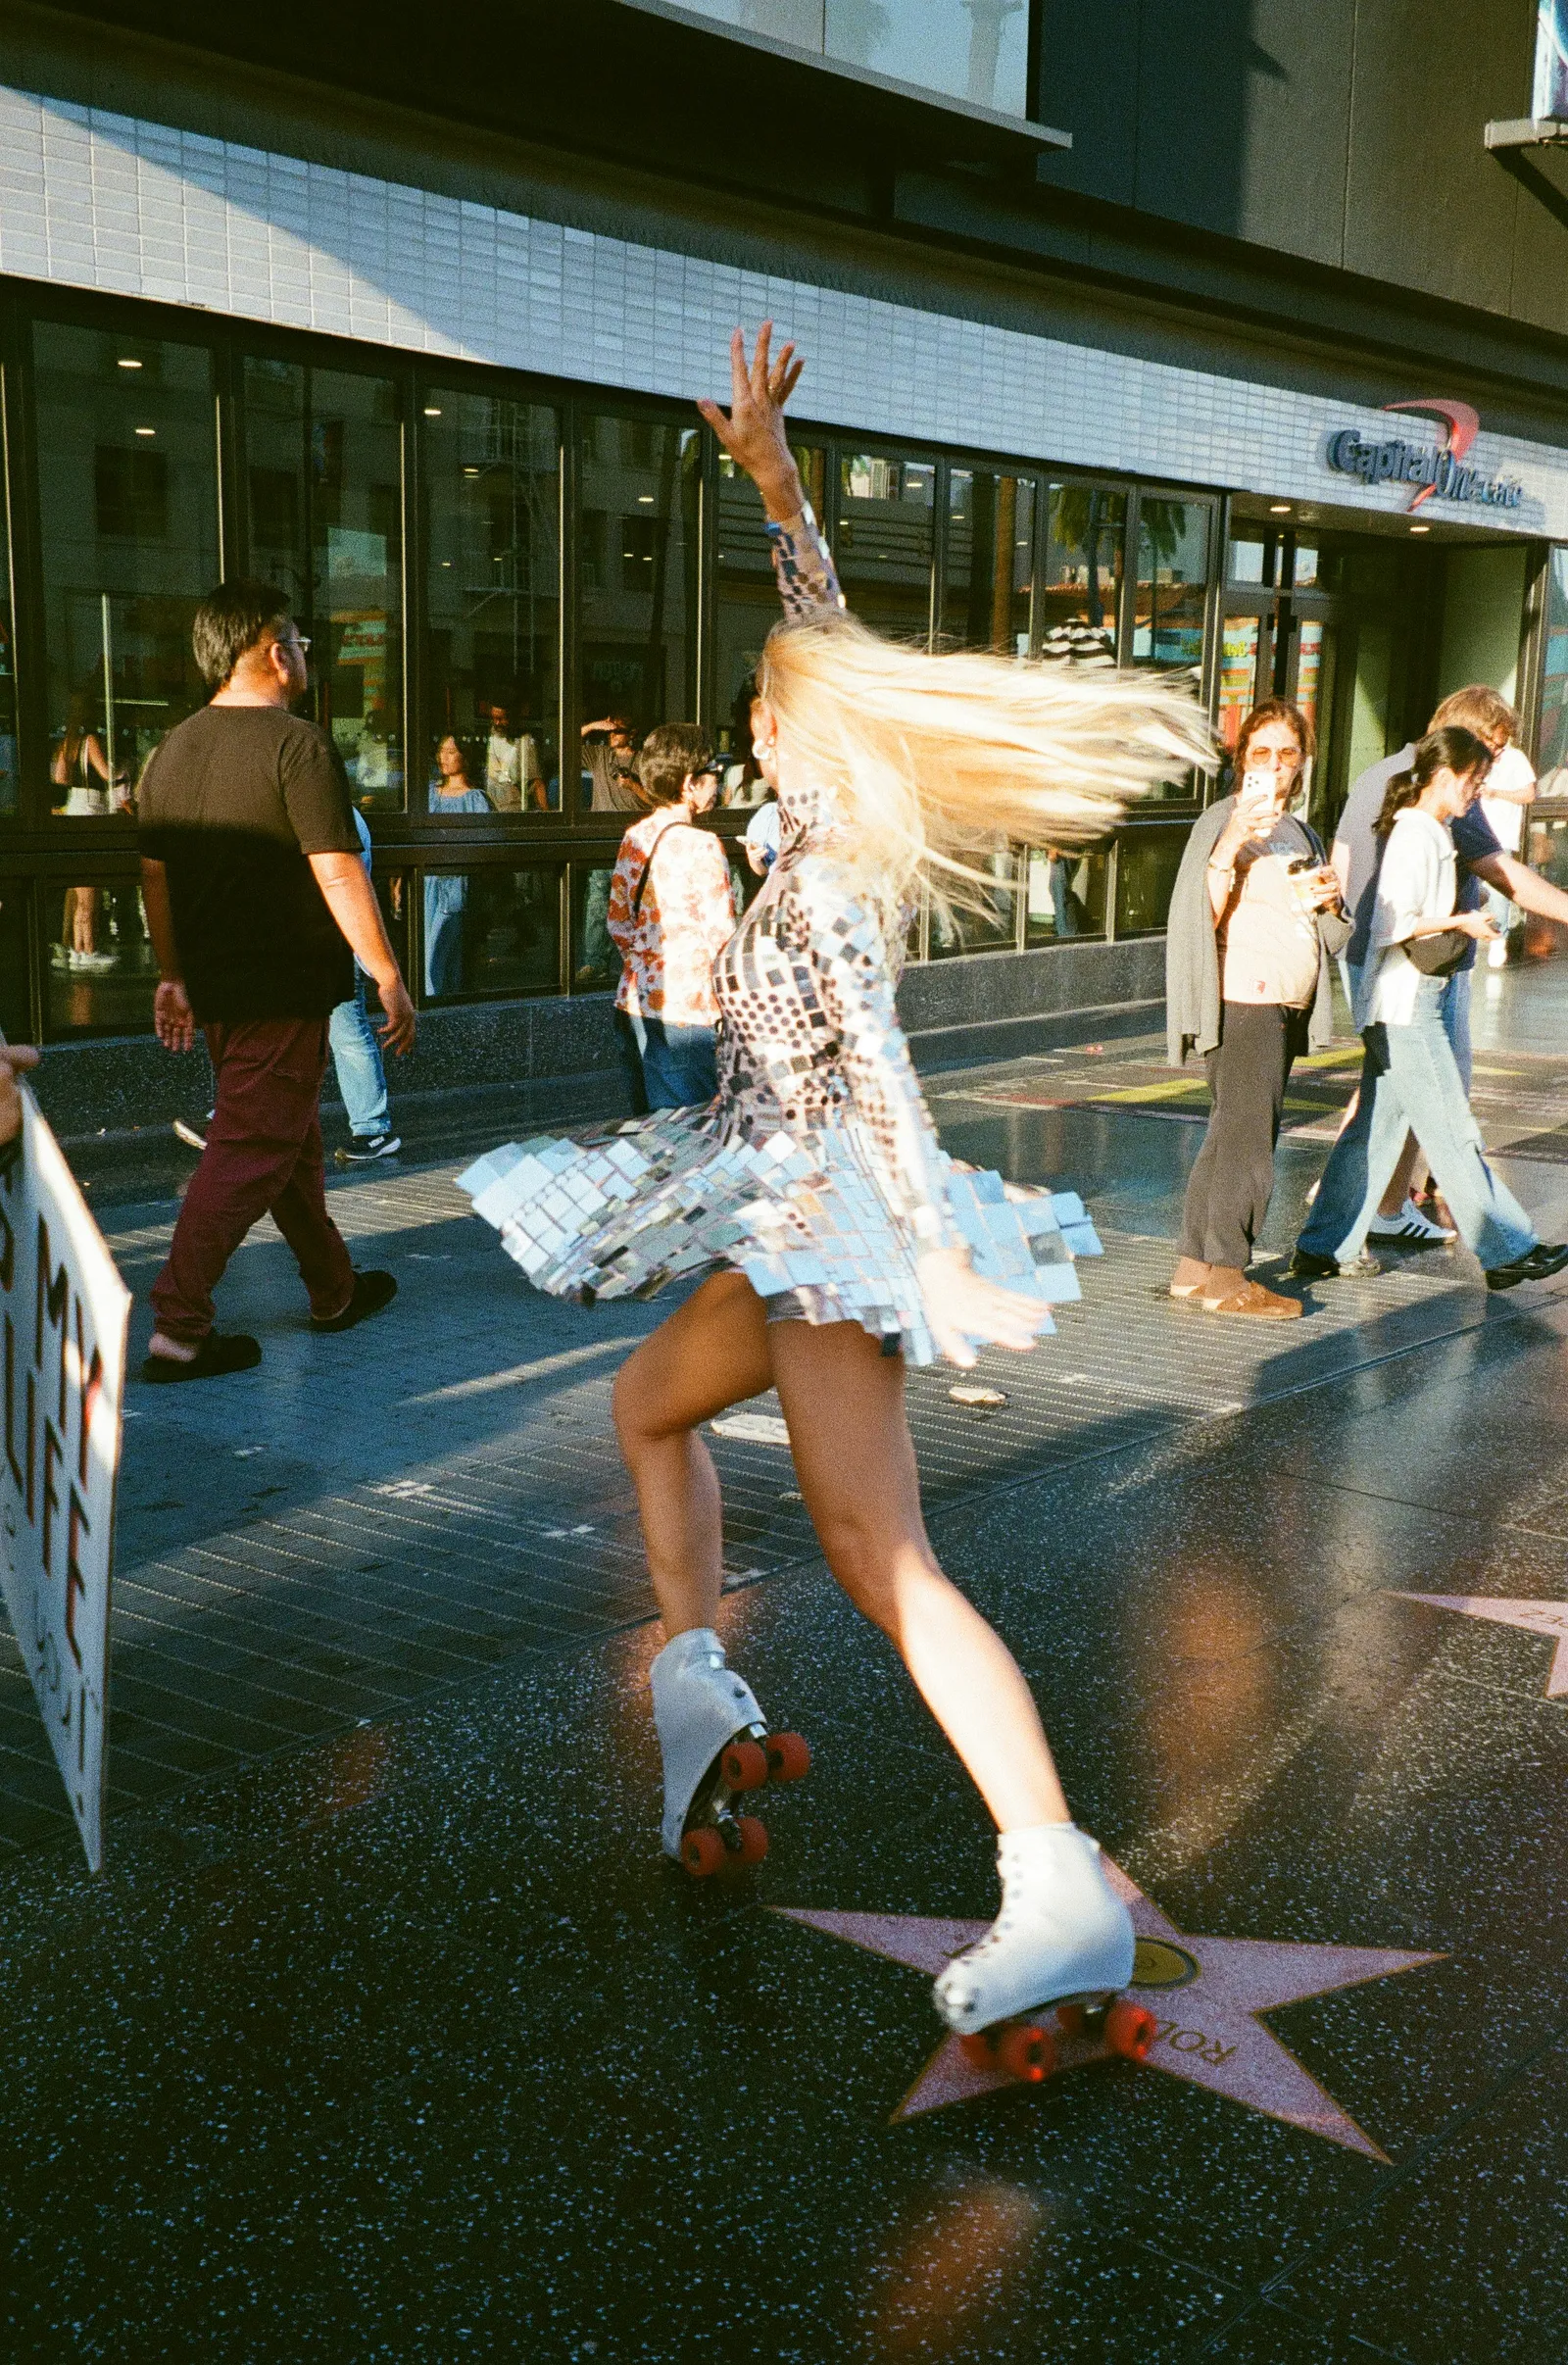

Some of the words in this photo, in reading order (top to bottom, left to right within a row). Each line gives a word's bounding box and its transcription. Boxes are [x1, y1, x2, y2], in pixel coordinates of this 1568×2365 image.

[1327, 429, 1438, 485] Capital
[35, 1211, 104, 1491] MY
[5, 1311, 90, 1671] LIFE
[1154, 2019, 1237, 2066] ROL
